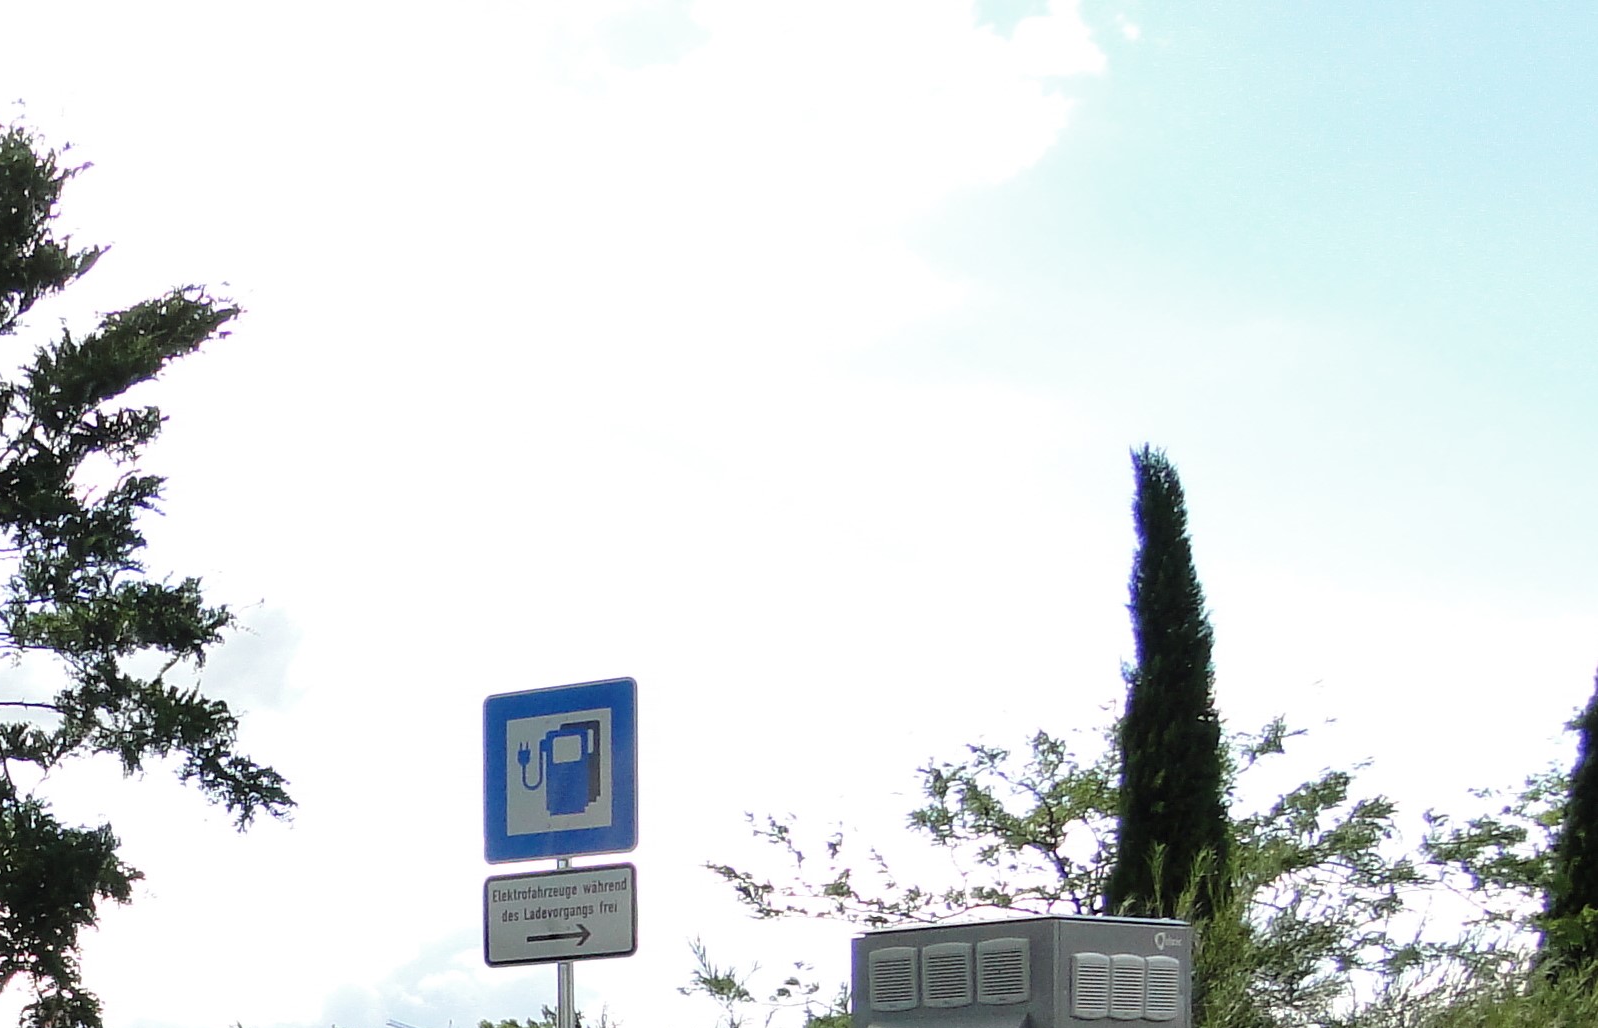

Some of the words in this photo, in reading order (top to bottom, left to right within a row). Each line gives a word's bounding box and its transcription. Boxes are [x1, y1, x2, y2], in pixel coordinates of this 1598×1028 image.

[492, 885, 578, 903] Elektrofahrzeuge
[582, 877, 628, 895] während
[501, 909, 520, 923] des
[523, 903, 595, 921] Ladevorgangs
[598, 900, 619, 915] frei
